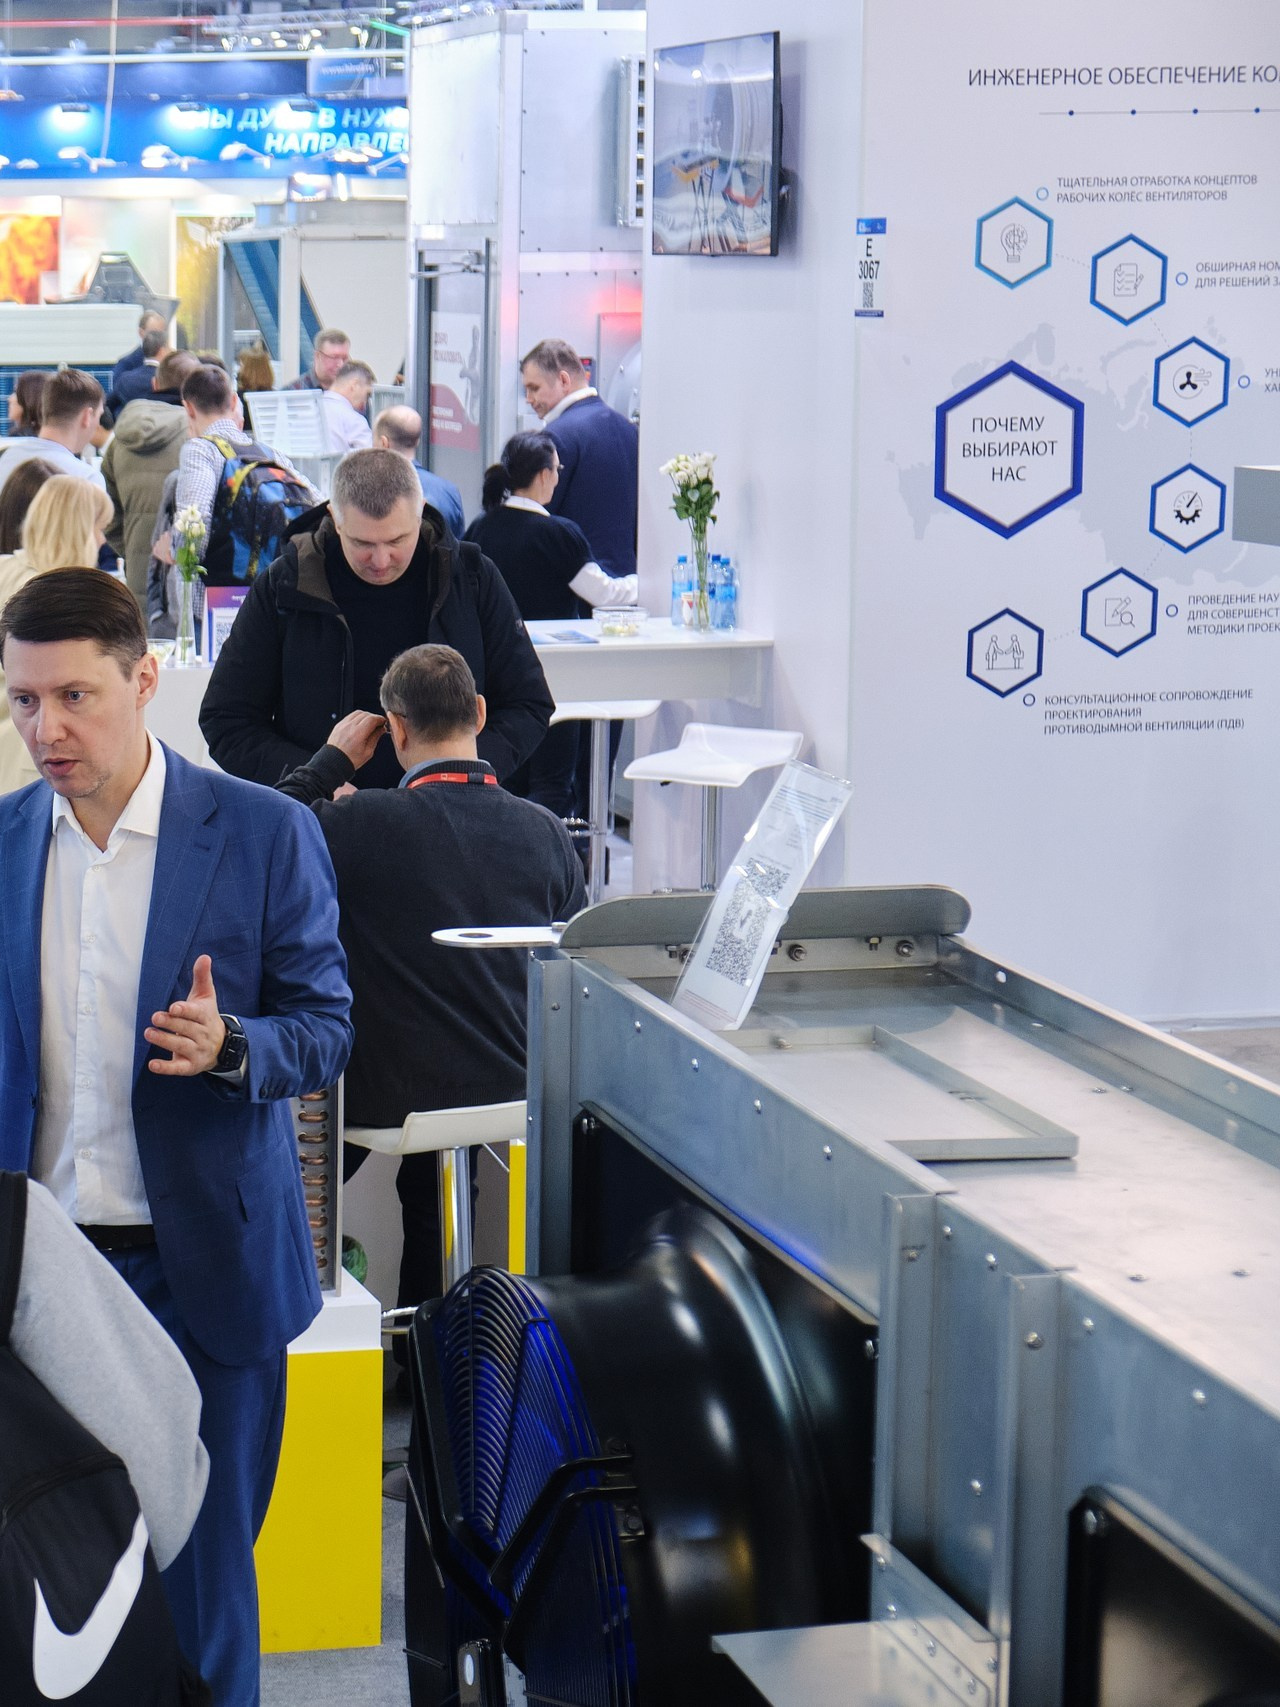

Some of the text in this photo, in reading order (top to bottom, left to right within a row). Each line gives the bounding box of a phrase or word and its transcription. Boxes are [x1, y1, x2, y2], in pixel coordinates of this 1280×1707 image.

[969, 64, 1280, 86] ИНЖЕНЕРНОЕ ОБЕСПЕЧЕНИЕ КО
[264, 131, 408, 154] НАПРАВЛЕ
[1057, 174, 1258, 189] ТЩАТЕЛЬНАЯ ОТРАБОТКА КОНЦЕПТОВ
[1056, 189, 1228, 203] РАБОЧИХ КОЛЁС ВЕНТИЛЯТОРОВ
[866, 238, 873, 257] E
[858, 260, 880, 279] 3067
[1195, 261, 1256, 273] ОБШИРНАЯ
[1195, 277, 1216, 288] ДЛЯ
[1219, 275, 1270, 287] РЕШЕНИЙ
[972, 416, 1045, 433] ПОЧЕМУ
[962, 440, 1058, 458] ВЫБИРАЮТ
[991, 465, 1027, 482] НАС
[1188, 593, 1256, 606] ПРОВЕДЕНИЕ
[1187, 607, 1280, 621] ДЛЯ СОВЕРШЕНСТ
[1187, 623, 1245, 635] МЕТОДИКИ
[1044, 689, 1253, 705] КОНСУЛЬТАЦИОННОЕ СОПРОВОЖДЕНИЕ
[1044, 707, 1142, 720] ПРОЕКТИРОВАНИЯ
[1044, 718, 1245, 735] ПРОТИВОДЫМНОЙ ВЕНТИЛЯЦИИ (ПДВ)
